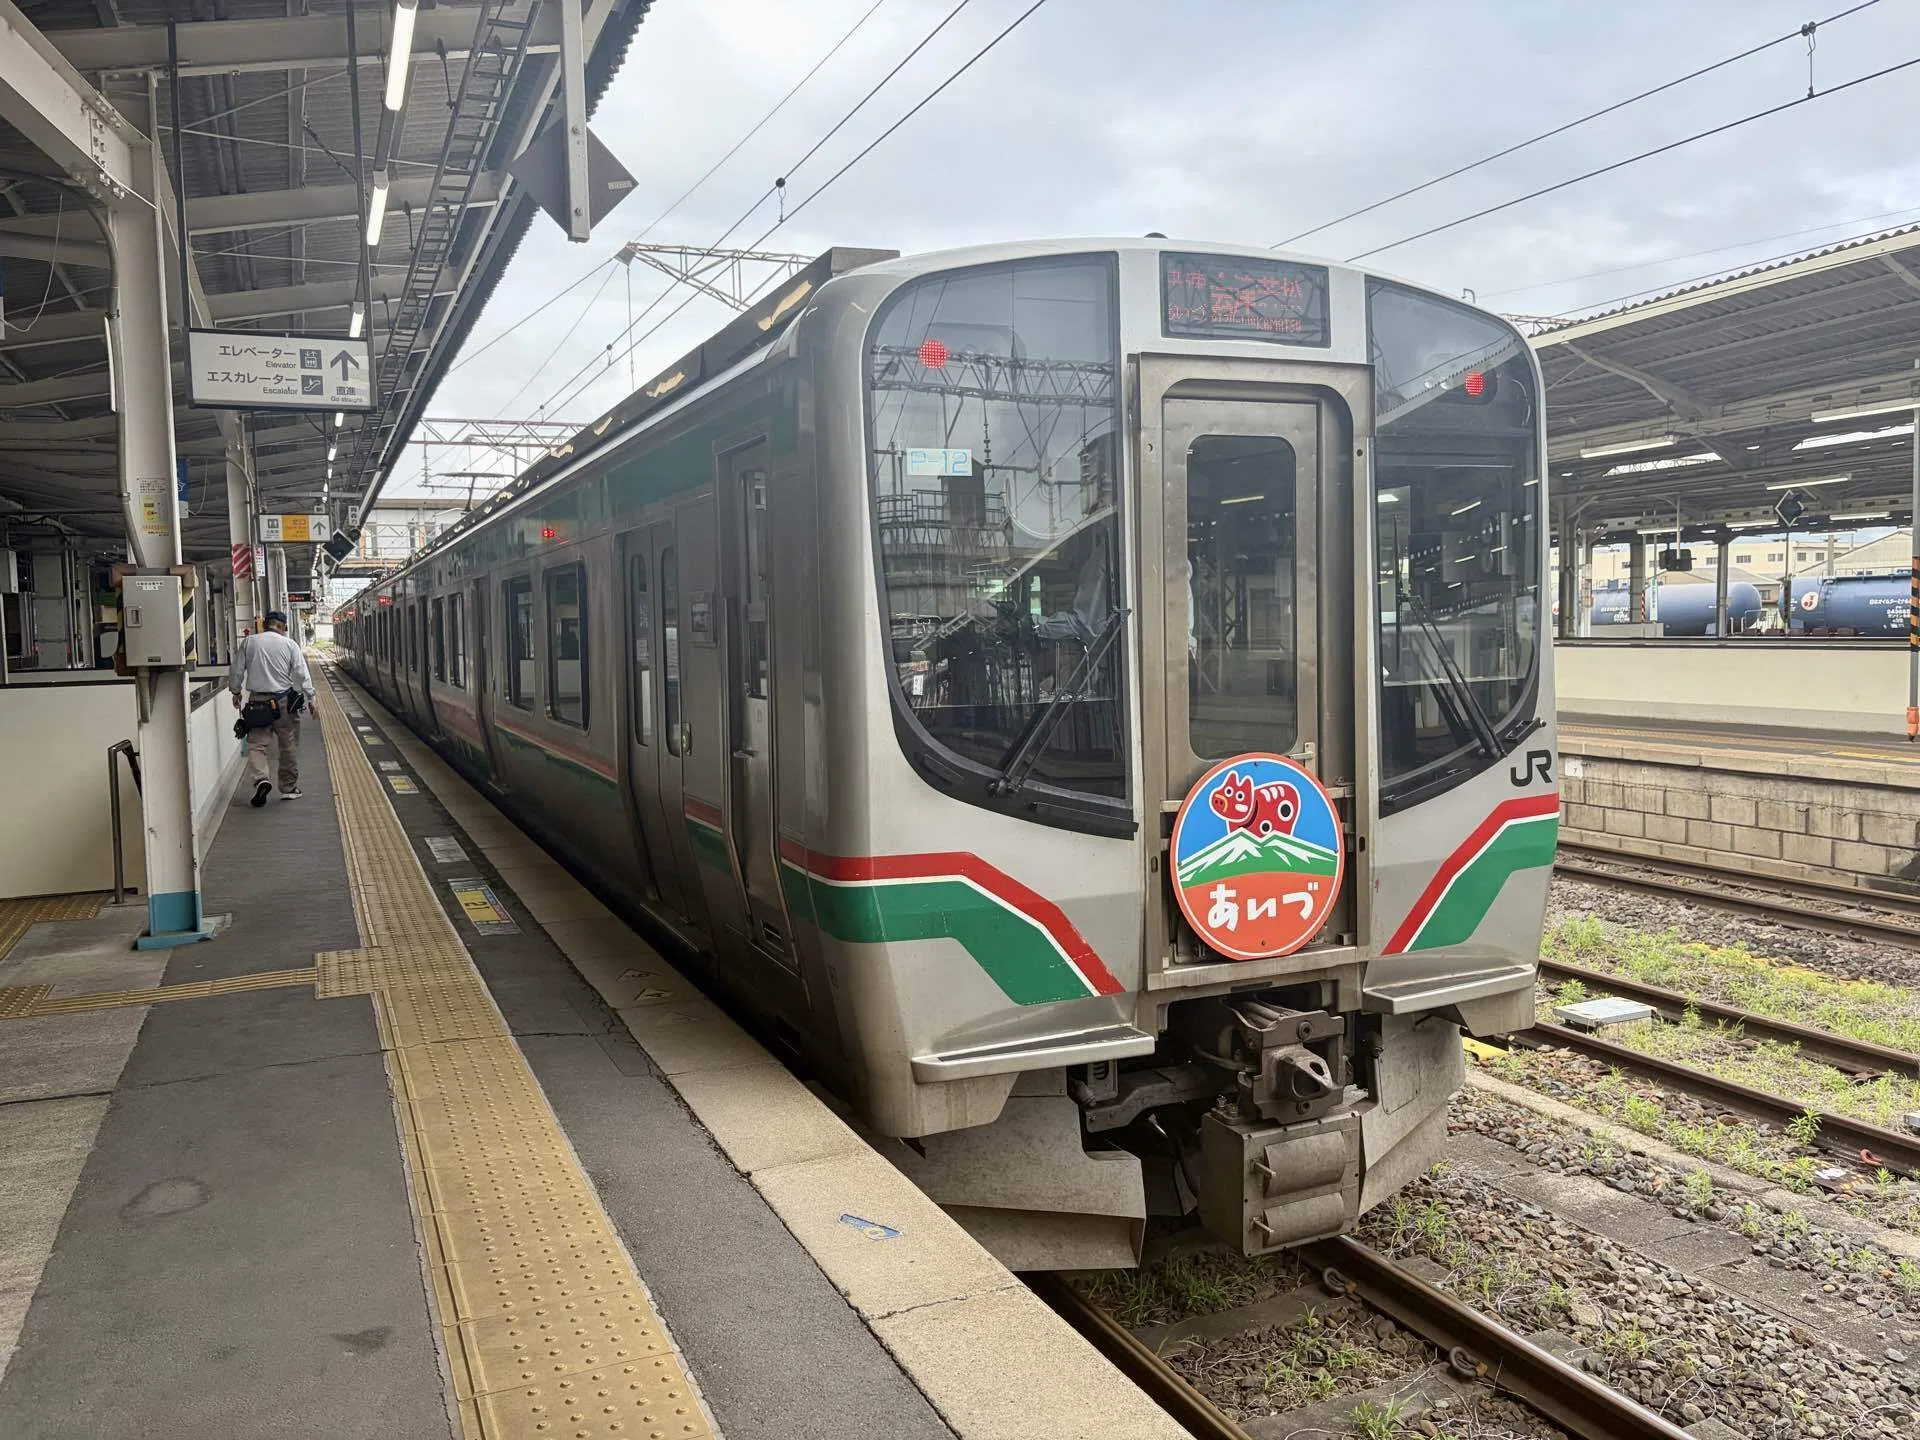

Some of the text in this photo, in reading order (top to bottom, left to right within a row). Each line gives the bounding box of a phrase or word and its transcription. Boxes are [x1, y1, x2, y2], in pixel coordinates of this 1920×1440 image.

[219, 345, 296, 359] エレベーター
[265, 361, 297, 369] Elevator
[207, 371, 298, 385] エスカレーター
[263, 386, 298, 395] Escalator
[336, 386, 356, 396] 直進
[330, 395, 341, 403] Go
[911, 451, 968, 474] P-12
[1511, 749, 1552, 787] JR
[1207, 882, 1320, 932] あいづ
